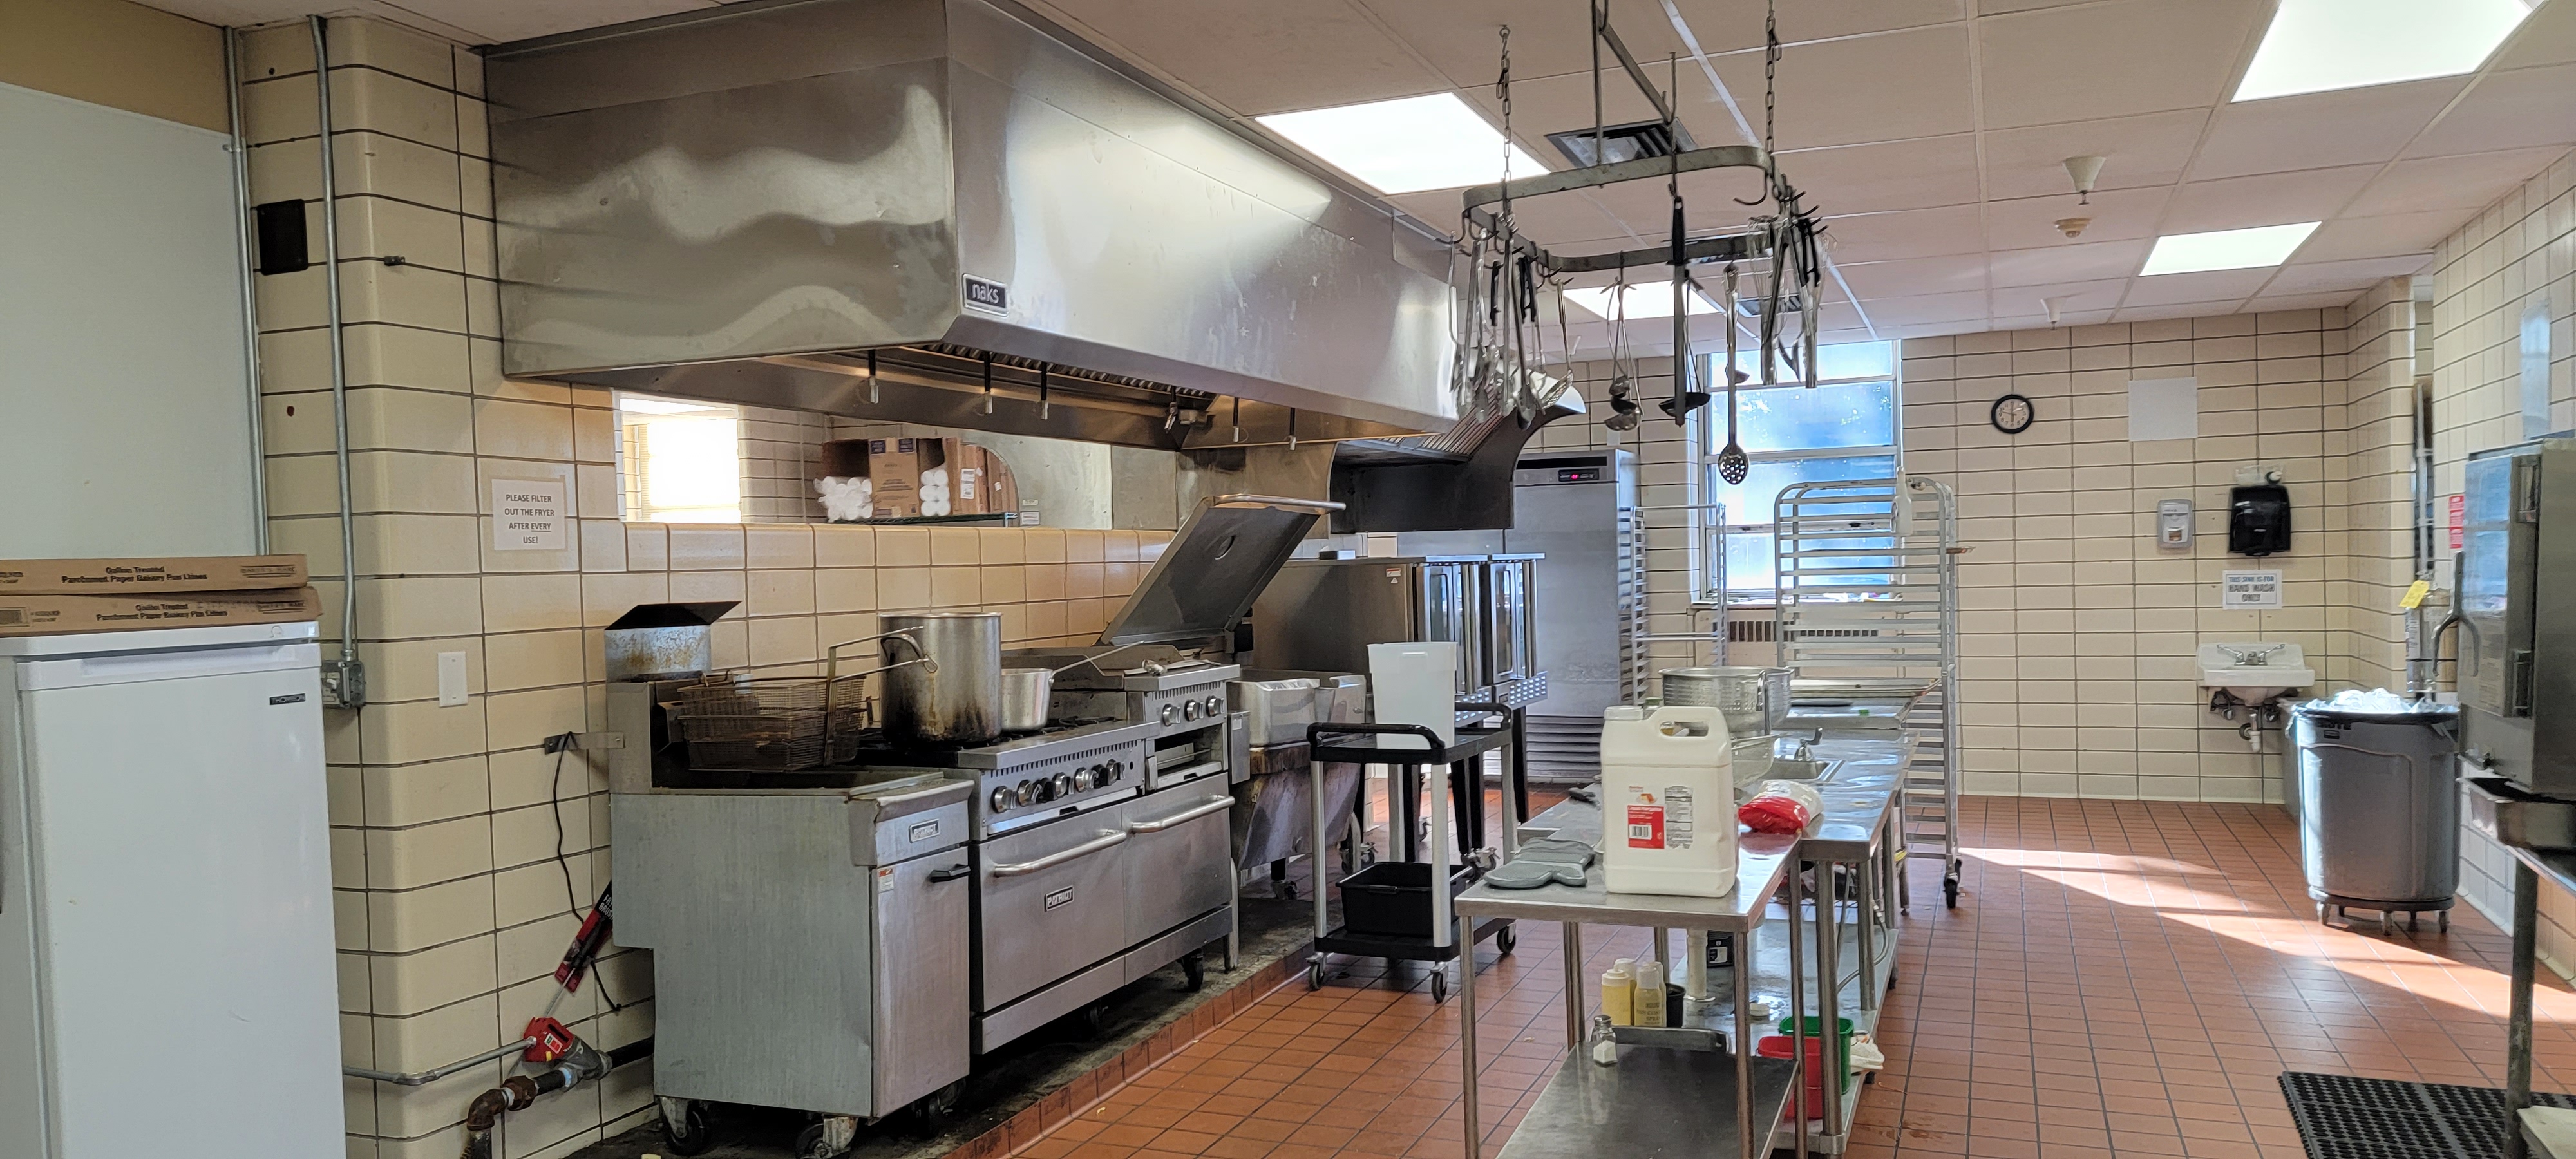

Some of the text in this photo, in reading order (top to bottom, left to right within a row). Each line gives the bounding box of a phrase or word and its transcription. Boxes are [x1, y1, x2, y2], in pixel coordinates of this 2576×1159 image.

[972, 283, 999, 304] naks
[506, 494, 552, 503] PLEASE FILTER
[531, 522, 551, 531] EVERY
[111, 575, 134, 583] Paper
[1047, 889, 1073, 907] PATRIOT
